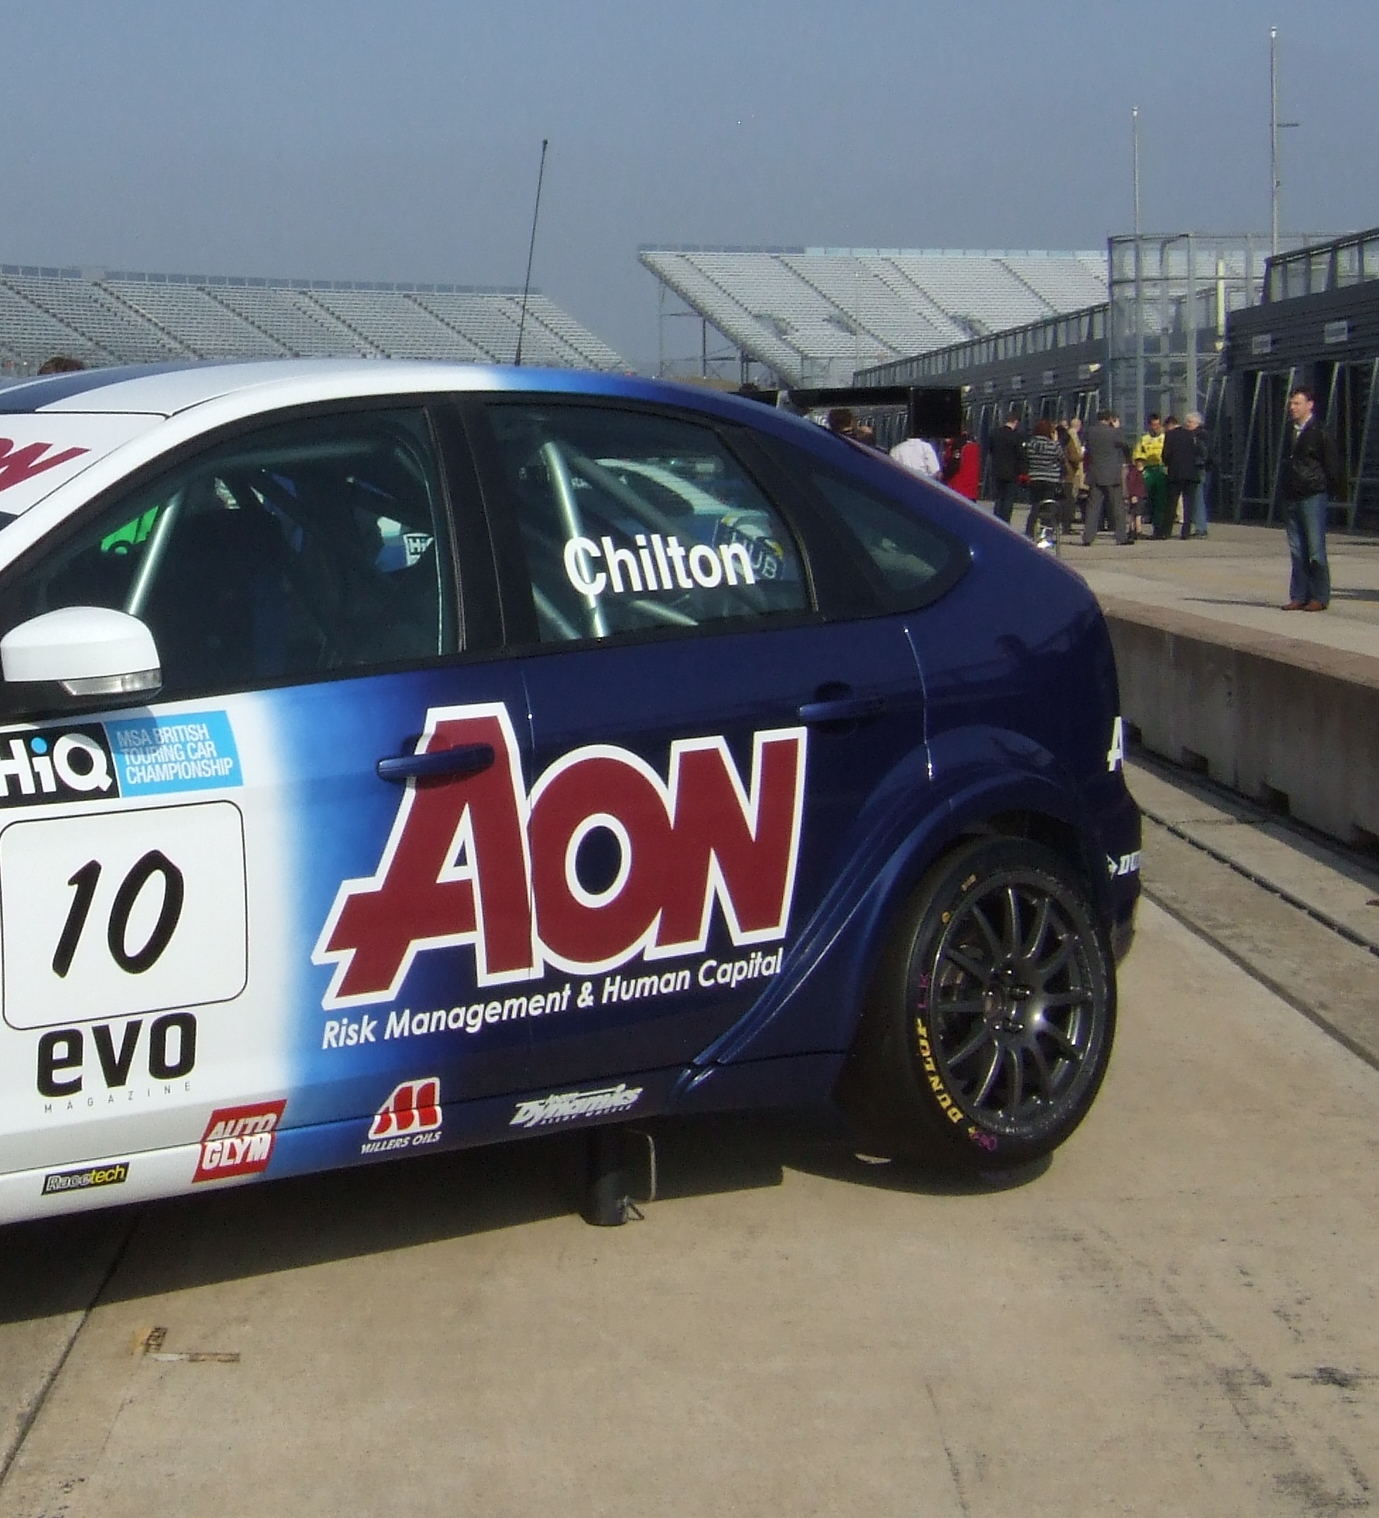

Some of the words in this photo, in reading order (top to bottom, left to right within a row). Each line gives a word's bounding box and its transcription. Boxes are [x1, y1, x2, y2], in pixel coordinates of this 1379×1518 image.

[564, 533, 755, 595] Chilton
[117, 731, 152, 746] MSA
[155, 723, 209, 745] BRITISH
[123, 745, 184, 765] TOURING
[188, 741, 217, 758] CAR
[126, 756, 234, 785] CHAMPIONSHIP
[311, 702, 807, 1011] AON
[52, 850, 184, 978] 10
[323, 1014, 375, 1050] Risk
[385, 982, 570, 1035] Management
[577, 982, 594, 1008] &
[603, 969, 690, 1005] Human
[698, 948, 782, 989] Capital
[37, 1012, 197, 1098] evo
[45, 1082, 190, 1113] MAGAZINE
[206, 1113, 277, 1141] AUTO
[202, 1133, 272, 1171] GLYM
[361, 1137, 410, 1155] MILLERS
[412, 1131, 442, 1146] OILS
[46, 1165, 125, 1191] Racetech
